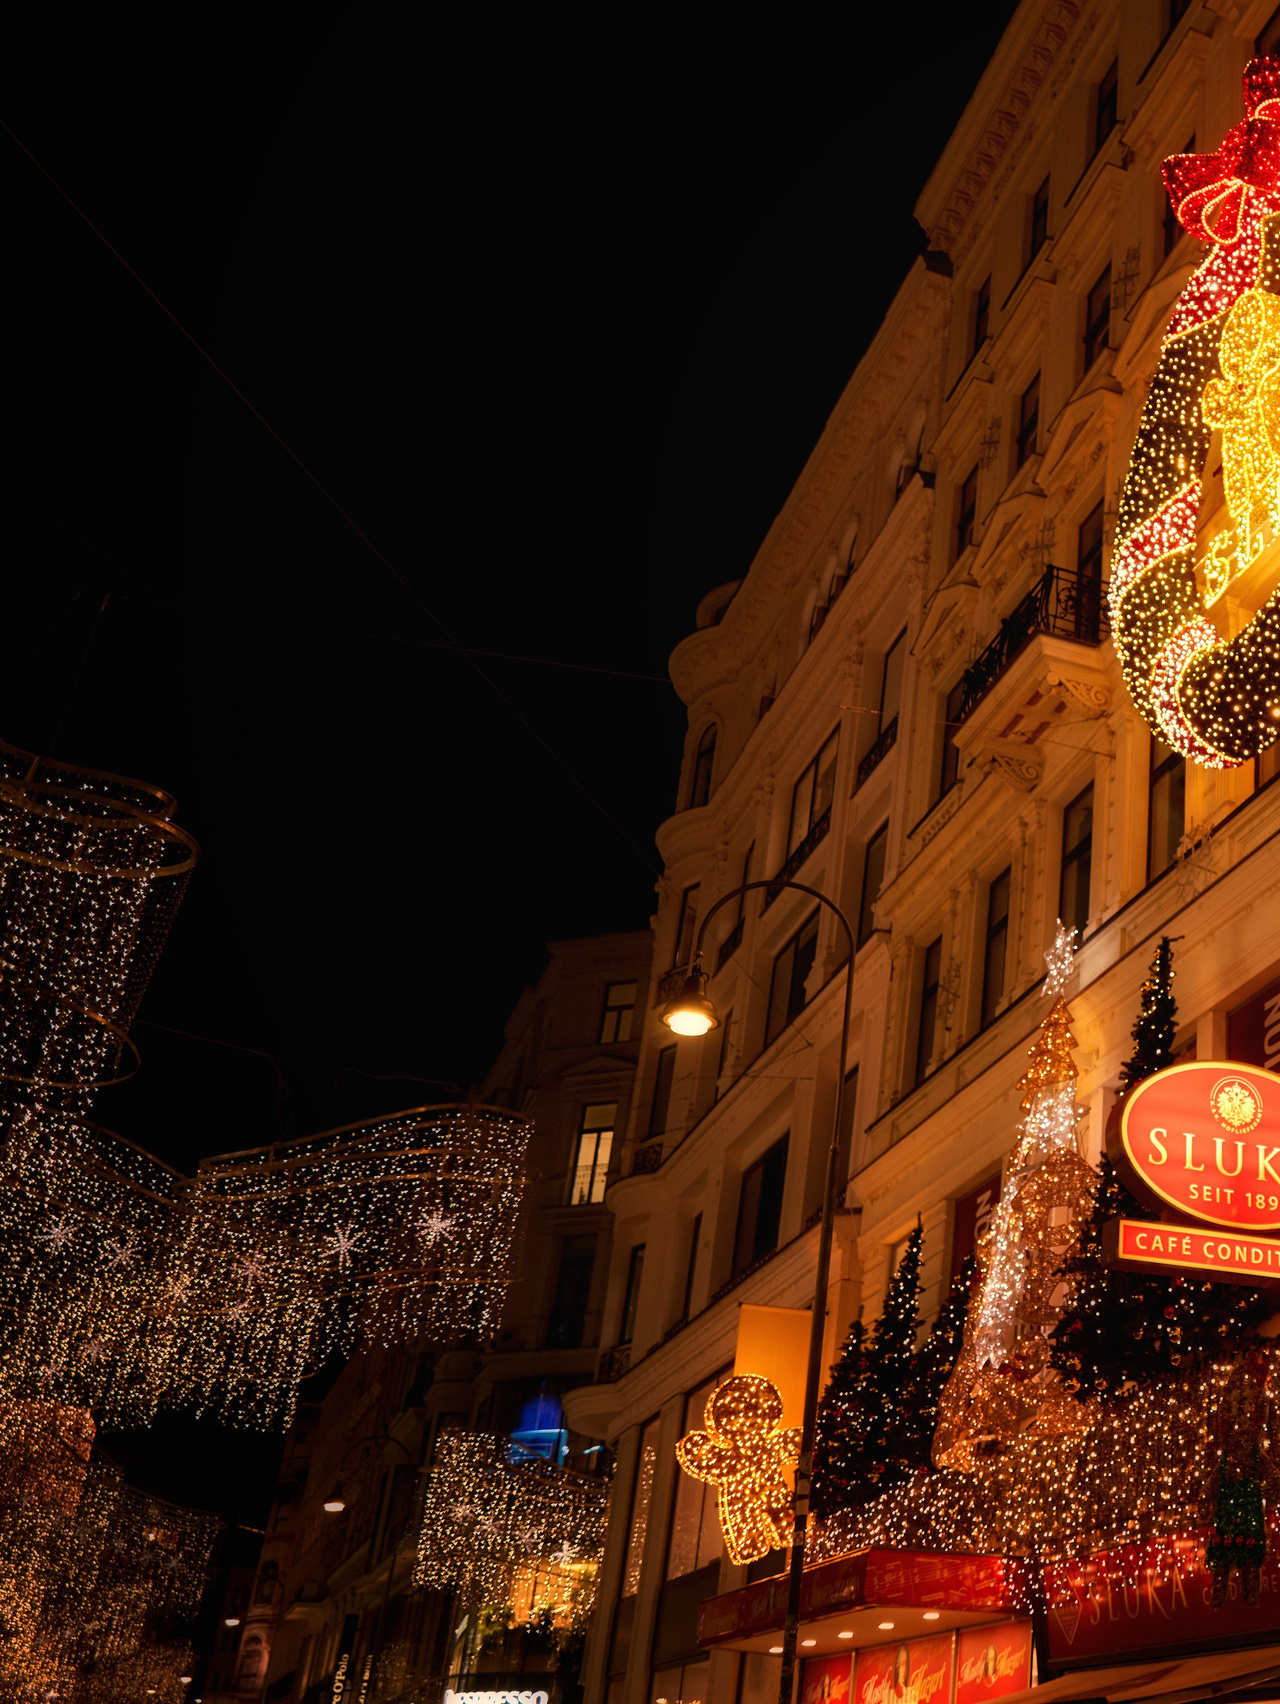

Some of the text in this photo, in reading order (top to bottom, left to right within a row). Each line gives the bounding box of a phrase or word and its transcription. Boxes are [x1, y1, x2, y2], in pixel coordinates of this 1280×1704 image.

[1189, 1183, 1235, 1204] SEIT
[1135, 1232, 1192, 1256] CAFÉ
[1089, 1563, 1190, 1626] SLUKA
